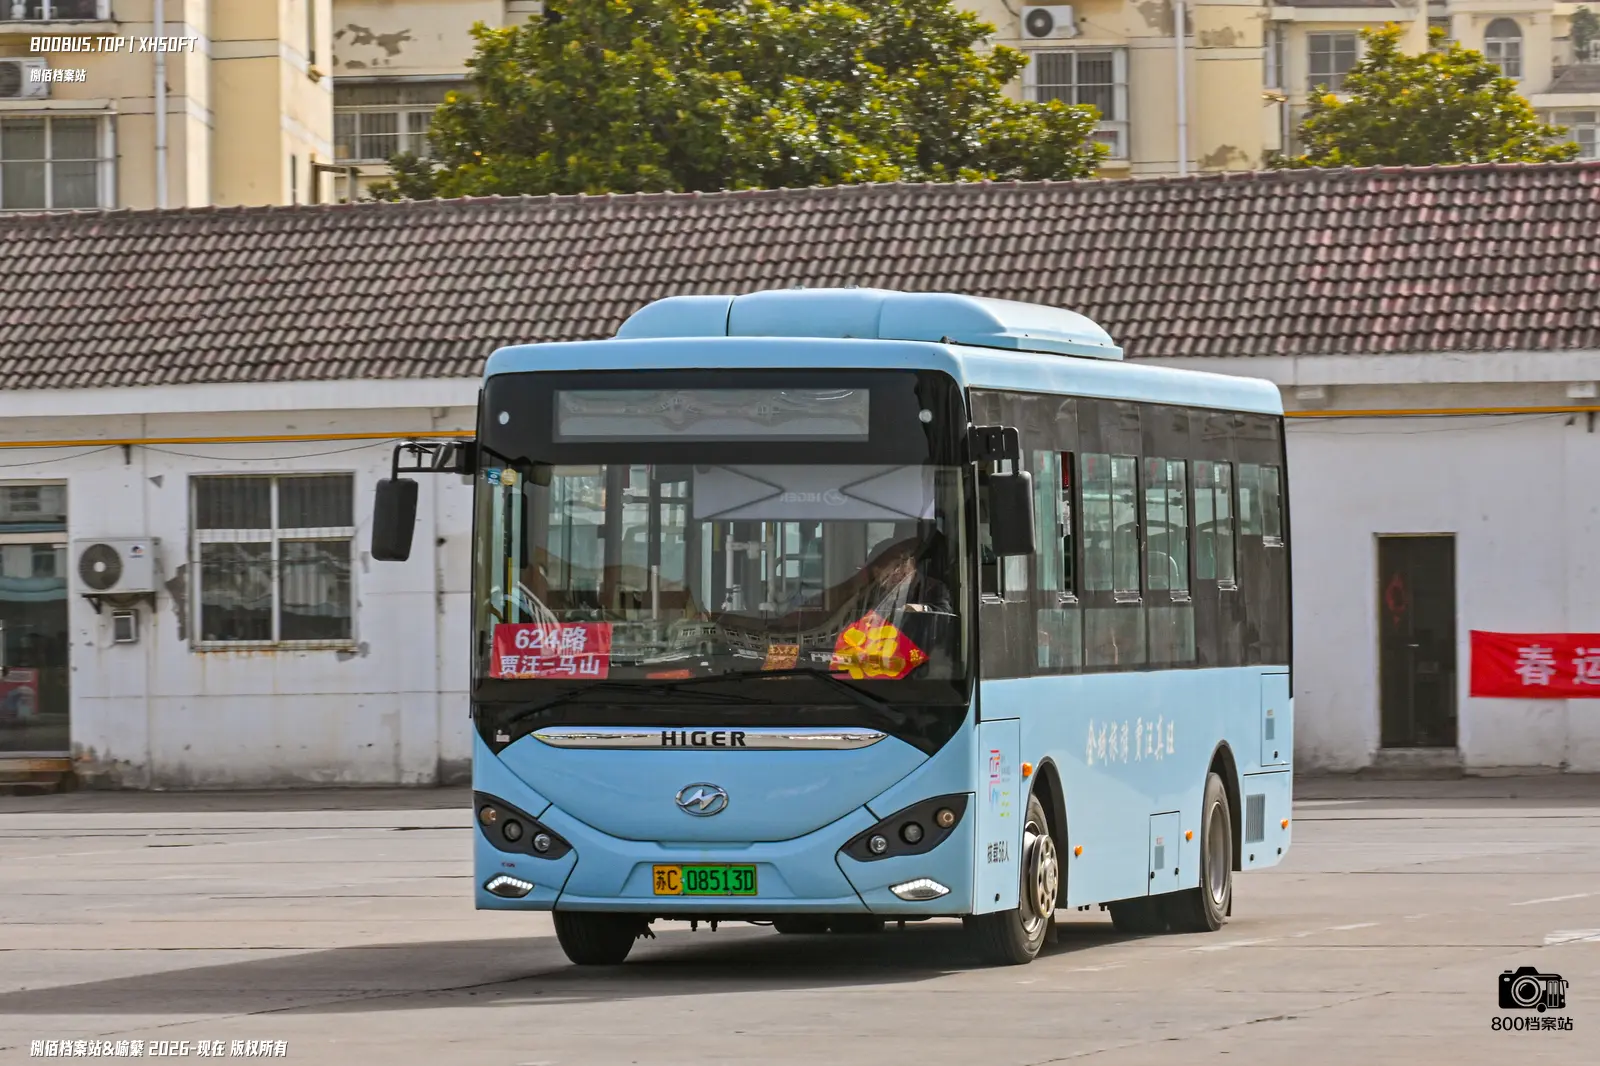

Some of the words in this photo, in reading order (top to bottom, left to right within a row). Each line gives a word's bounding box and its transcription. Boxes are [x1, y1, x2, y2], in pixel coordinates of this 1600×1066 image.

[515, 626, 587, 651] 624路
[661, 730, 746, 748] HIGER
[686, 869, 755, 891] 08513D
